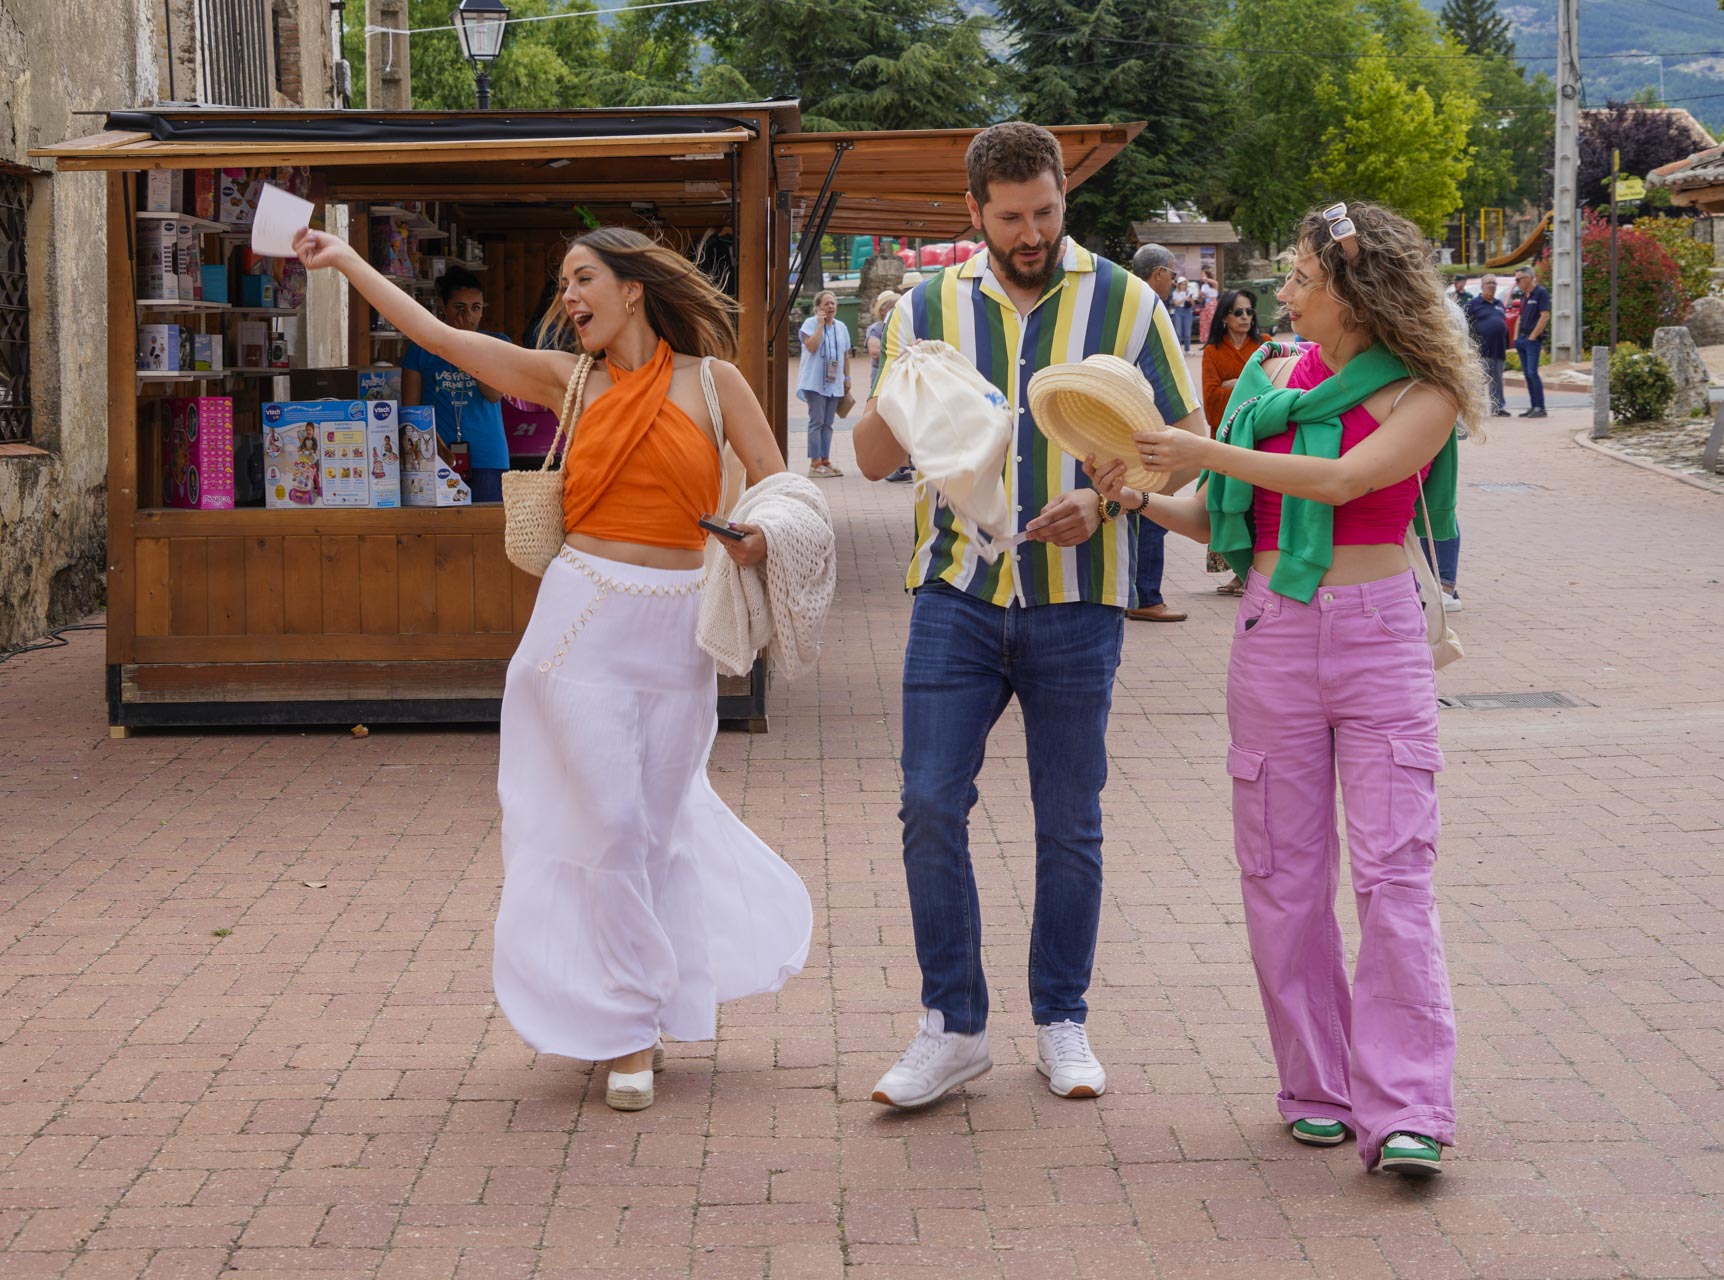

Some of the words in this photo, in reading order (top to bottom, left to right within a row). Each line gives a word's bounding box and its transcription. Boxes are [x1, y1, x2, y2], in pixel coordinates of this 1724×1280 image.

[435, 370, 452, 380] LAS
[442, 381, 464, 389] PRIME
[513, 423, 537, 436] 21
